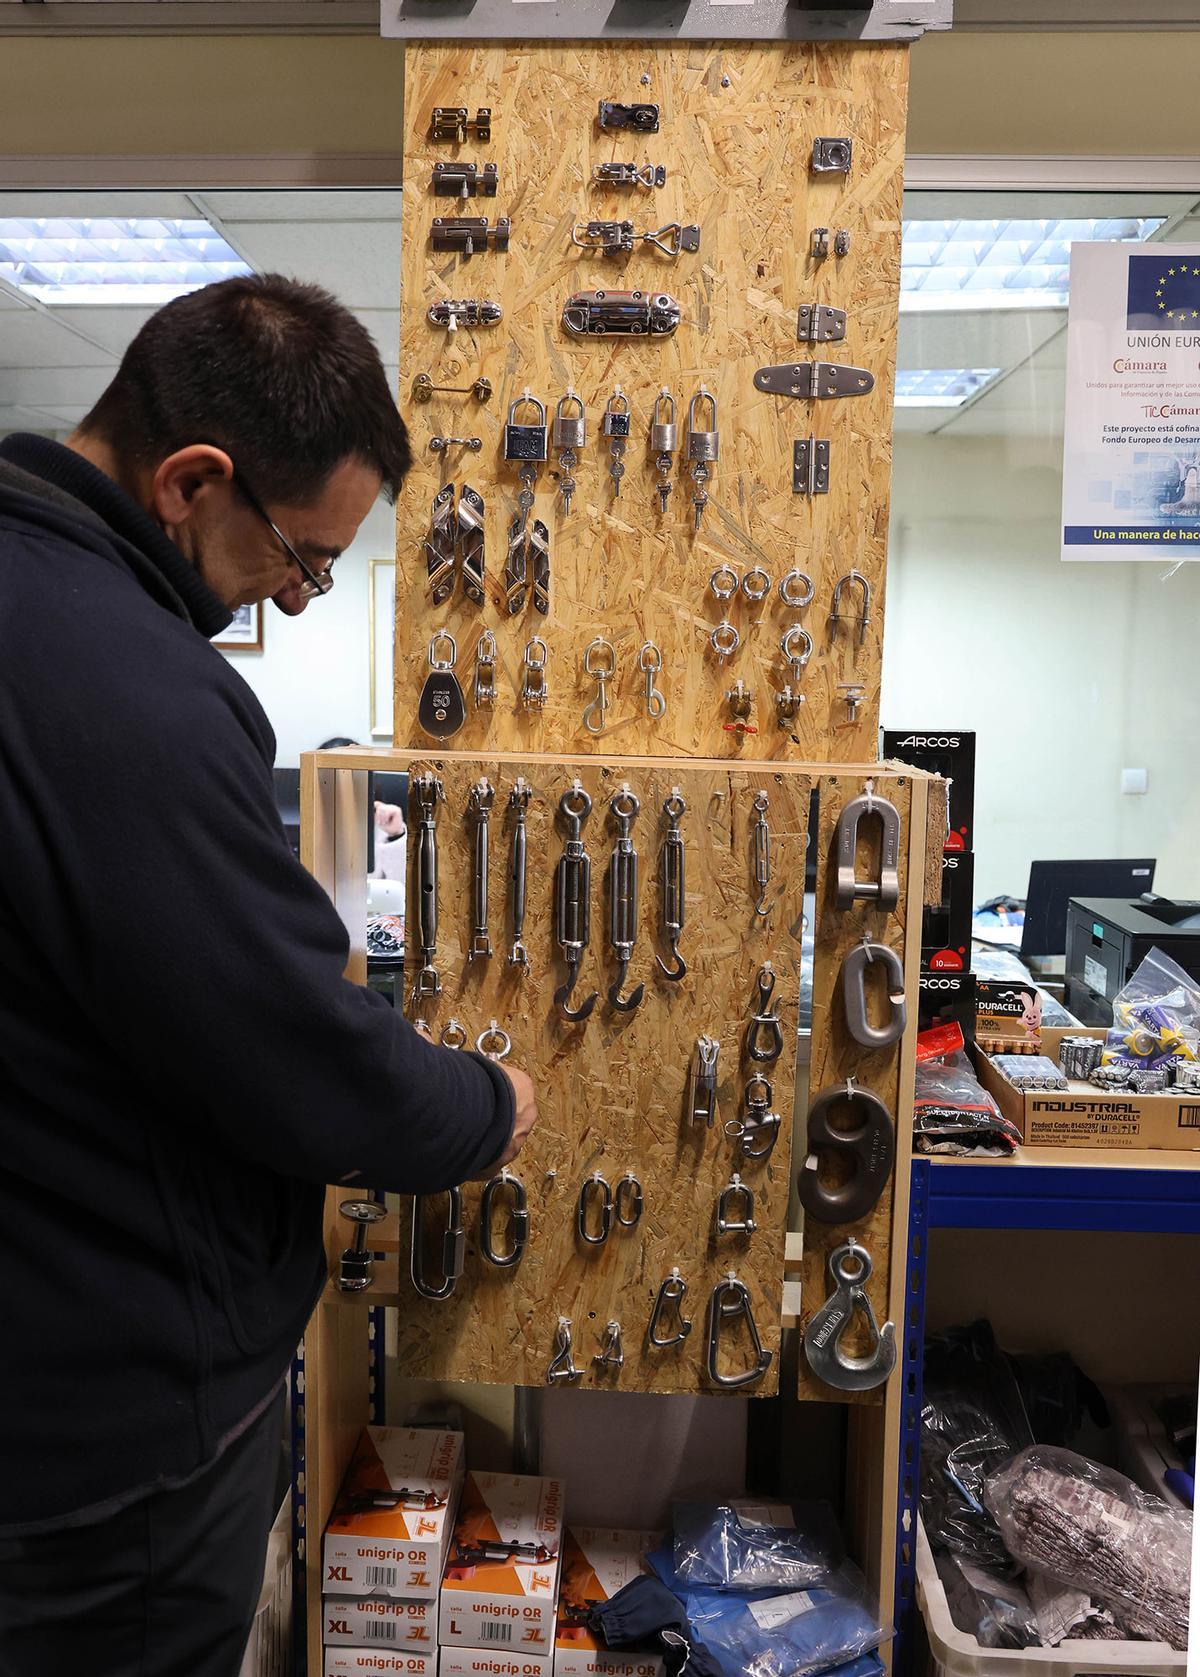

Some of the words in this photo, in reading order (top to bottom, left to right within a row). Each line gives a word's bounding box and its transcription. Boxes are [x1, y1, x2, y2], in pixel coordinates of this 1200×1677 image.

[1127, 334, 1171, 348] UNIÓN
[1176, 336, 1200, 348] EUR
[1113, 358, 1167, 374] Cámara
[1121, 425, 1156, 433] proyecto
[1158, 424, 1174, 432] está
[1128, 436, 1161, 444] Europeo
[1093, 529, 1115, 539] Una
[1118, 531, 1160, 539] manera
[1163, 529, 1177, 539] de
[1179, 529, 1200, 539] hac
[433, 695, 450, 707] 50
[897, 735, 960, 747] ARCOS
[919, 979, 961, 989] RCOS
[979, 1001, 1022, 1012] DURACELL
[1111, 1058, 1140, 1069] VARTA
[1032, 1101, 1140, 1113] INDUSTRIAL
[544, 1481, 561, 1517] unigrip
[357, 1546, 404, 1562] unigrip
[407, 1550, 427, 1561] OR
[327, 1565, 353, 1581] XL
[357, 1601, 404, 1616] unigrip
[407, 1604, 426, 1616] OR
[473, 1603, 519, 1618] unigrip
[522, 1607, 541, 1618] OR
[328, 1619, 353, 1634] XL
[450, 1620, 462, 1634] L
[356, 1656, 404, 1670] unigrip
[407, 1659, 425, 1670] OR
[472, 1660, 519, 1675] unigrip
[522, 1664, 541, 1675] OR
[586, 1661, 634, 1676] unigrip
[637, 1665, 656, 1676] OR
